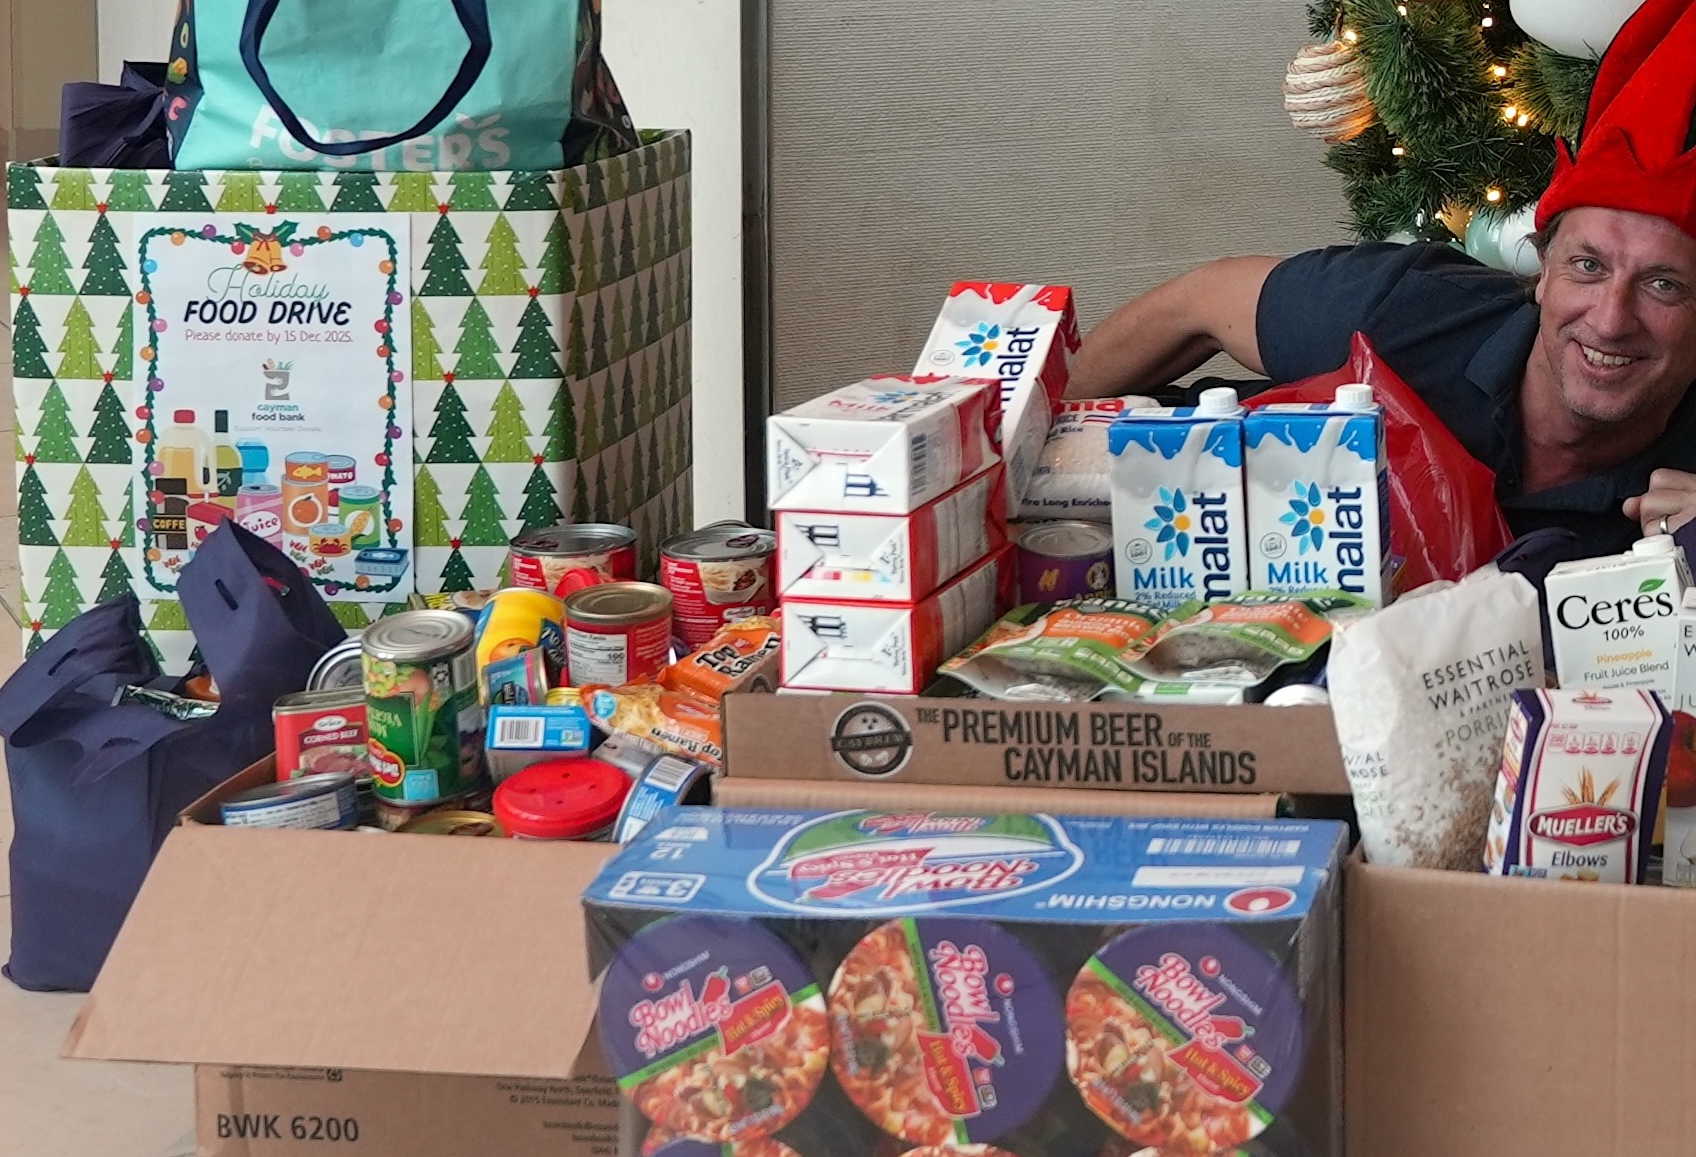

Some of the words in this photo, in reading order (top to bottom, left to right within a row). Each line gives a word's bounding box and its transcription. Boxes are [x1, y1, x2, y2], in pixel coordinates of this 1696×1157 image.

[206, 263, 330, 306] Holiday
[183, 299, 258, 324] FOOD
[268, 300, 352, 325] DRIVE
[185, 329, 221, 341] Please
[225, 329, 263, 342] donate
[267, 329, 281, 345] by
[284, 330, 297, 342] 15
[300, 330, 322, 342] Dec
[997, 326, 1040, 413] malat
[252, 412, 276, 421] food
[279, 412, 305, 421] bank
[257, 404, 299, 413] cayman
[1043, 498, 1069, 507] Long
[1134, 566, 1196, 590] Milk
[1268, 561, 1329, 585] Milk
[1135, 592, 1152, 601] 2%
[1154, 590, 1197, 601] Reduced
[1557, 591, 1674, 630] Ceres
[1603, 625, 1645, 641] 100%
[697, 645, 739, 668] Top
[717, 632, 781, 678] Ramen
[1423, 639, 1530, 690] ESSENTIAL
[1596, 649, 1653, 664] Pineapple
[1584, 669, 1608, 682] Fruit
[1611, 665, 1637, 678] Juice
[1639, 660, 1669, 673] Blend
[1428, 660, 1535, 710] WAITROSE
[916, 707, 940, 724] THE
[943, 709, 1079, 744] PREMIUM
[1091, 712, 1164, 747] BEER
[1168, 732, 1185, 747] OF
[1187, 732, 1211, 748] THE
[1004, 747, 1123, 783] CAYMAN
[1132, 750, 1258, 785] ISLANDS
[1537, 812, 1629, 836] MUELLER'S
[651, 847, 685, 860] 12
[1551, 851, 1609, 867] Elbows
[825, 857, 1040, 884] Noodles
[667, 878, 693, 897] 3
[877, 874, 1024, 901] Bowl
[1049, 893, 1217, 909] NONGSHIM
[663, 950, 711, 980] NONGSHIM
[961, 944, 1001, 1024] Bowl
[1159, 952, 1228, 1018] Bowl
[629, 978, 695, 1028] Bowl
[928, 940, 979, 1057] Noodles
[1132, 964, 1228, 1052] Noodles
[635, 995, 734, 1059] Noodles
[217, 1112, 283, 1139] BWK
[290, 1115, 359, 1142] 6200
